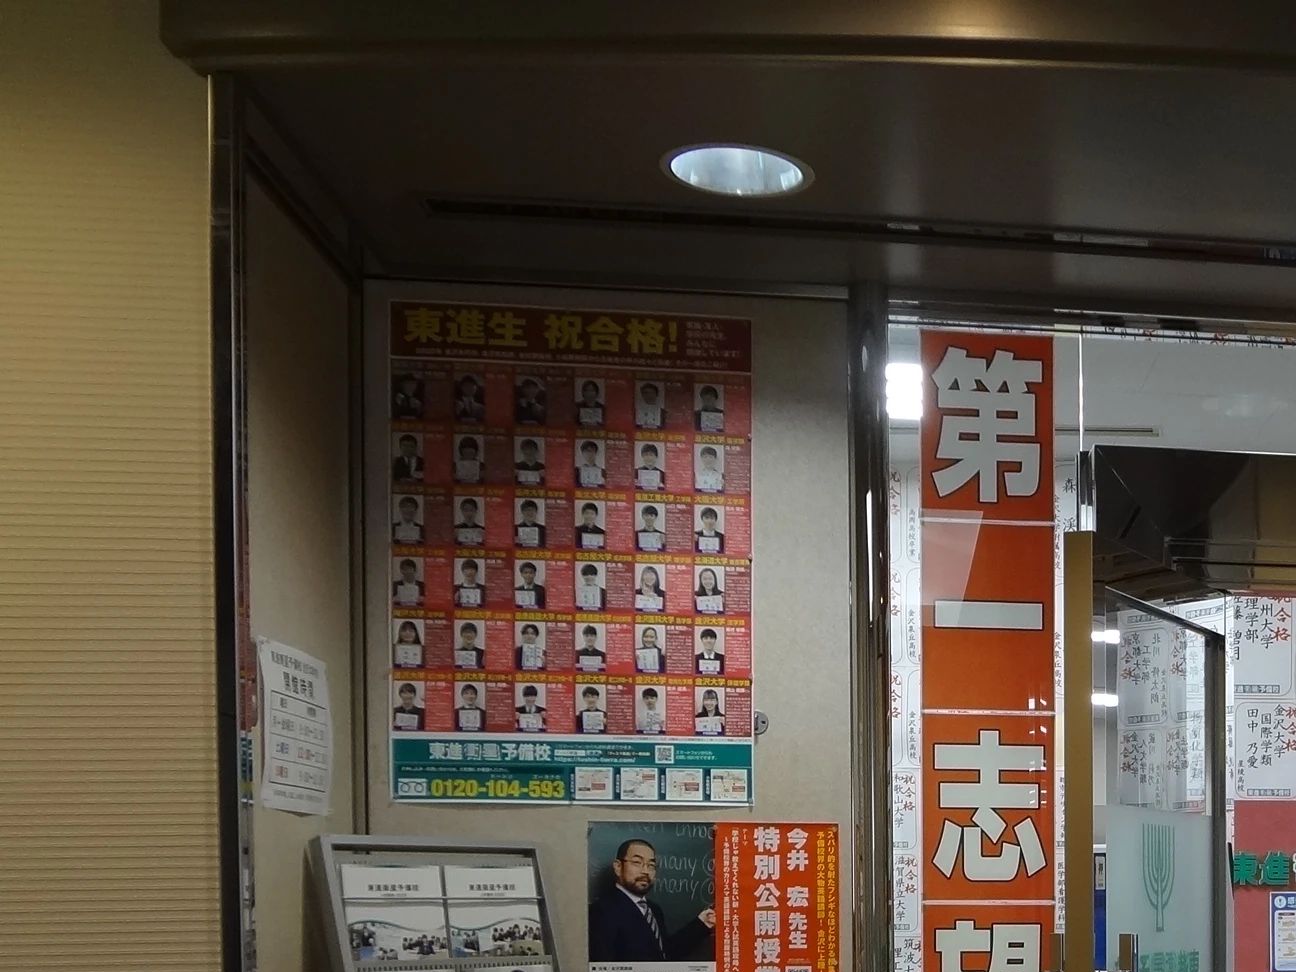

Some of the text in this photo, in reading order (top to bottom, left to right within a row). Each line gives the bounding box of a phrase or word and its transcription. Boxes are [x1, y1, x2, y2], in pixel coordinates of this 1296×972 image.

[403, 307, 528, 347] 東進生
[544, 312, 678, 354] 祝合格!
[429, 743, 551, 761] 東進衛星予備校
[1247, 708, 1259, 768] 田中 乃愛
[1261, 713, 1272, 766] 国際学類
[1273, 704, 1287, 758] 金沢大学
[431, 779, 565, 798] 0120-104-593
[894, 774, 905, 827] 和歌山大学
[787, 828, 808, 949] 今井 宏 先生
